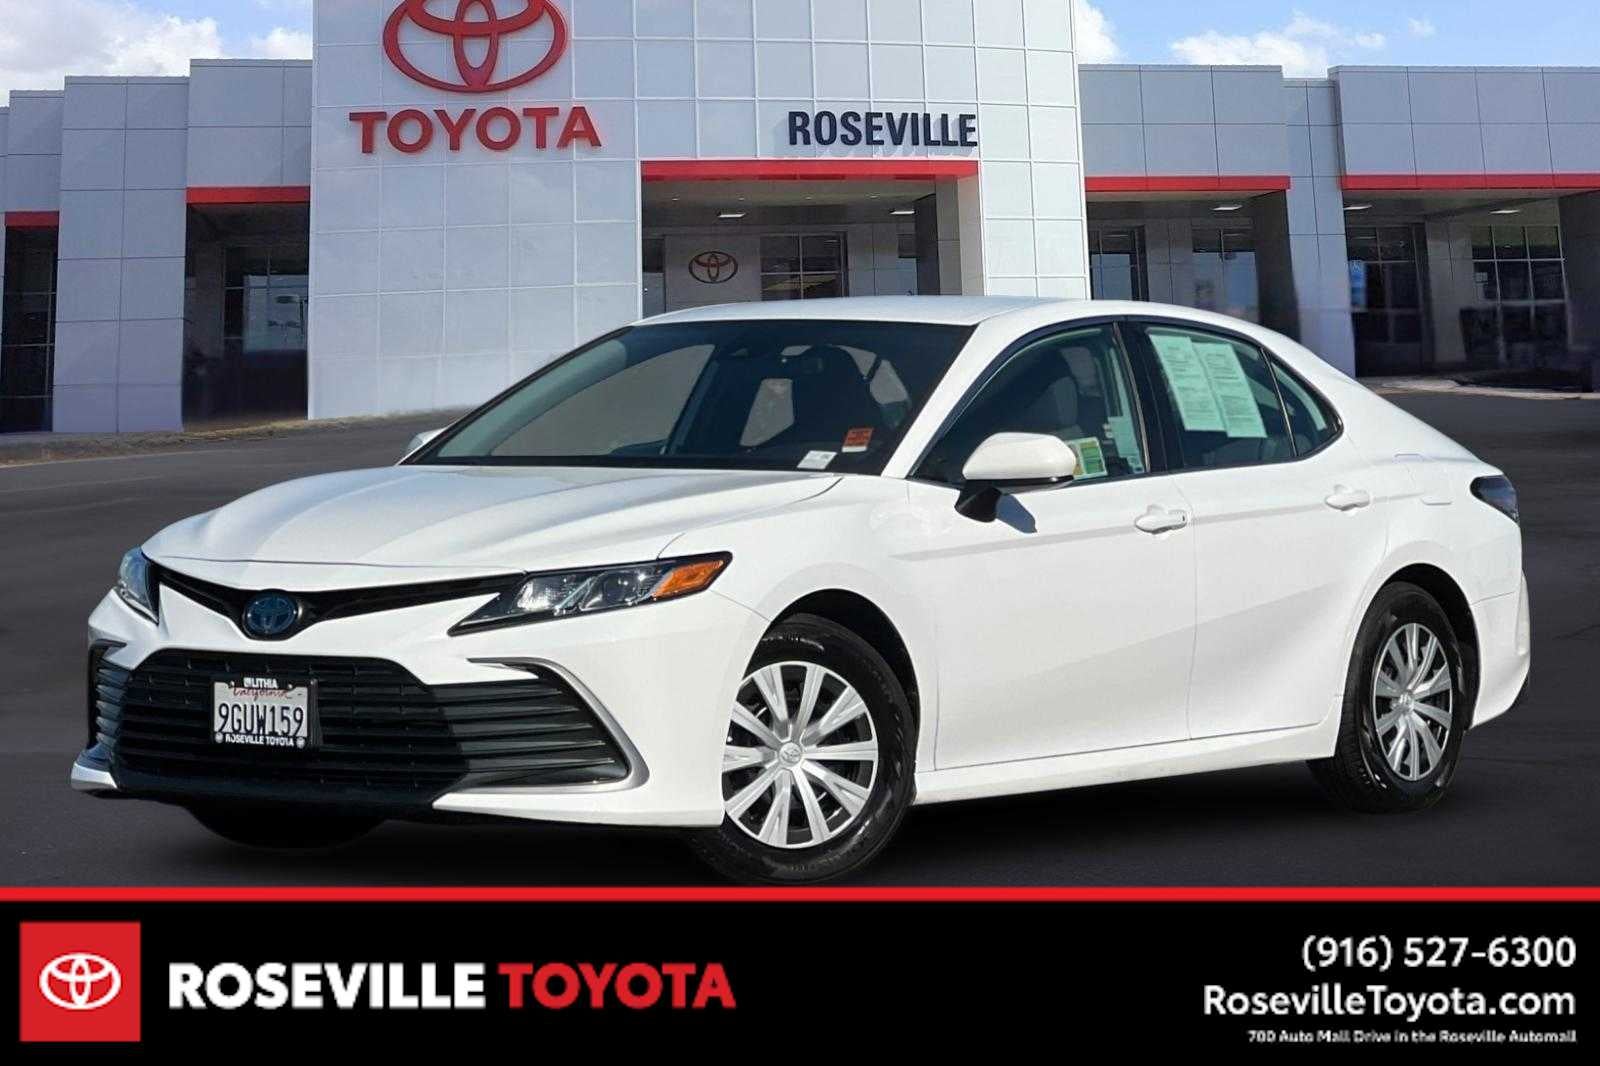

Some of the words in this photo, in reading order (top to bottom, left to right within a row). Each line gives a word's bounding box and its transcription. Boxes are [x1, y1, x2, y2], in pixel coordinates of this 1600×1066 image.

[349, 106, 603, 155] TOYOTA
[788, 111, 978, 147] ROSEVILLE
[252, 678, 279, 689] LITHIA
[218, 702, 304, 737] 9GUW159
[225, 734, 264, 745] ROSEVILLE
[266, 736, 294, 747] TOYOTA
